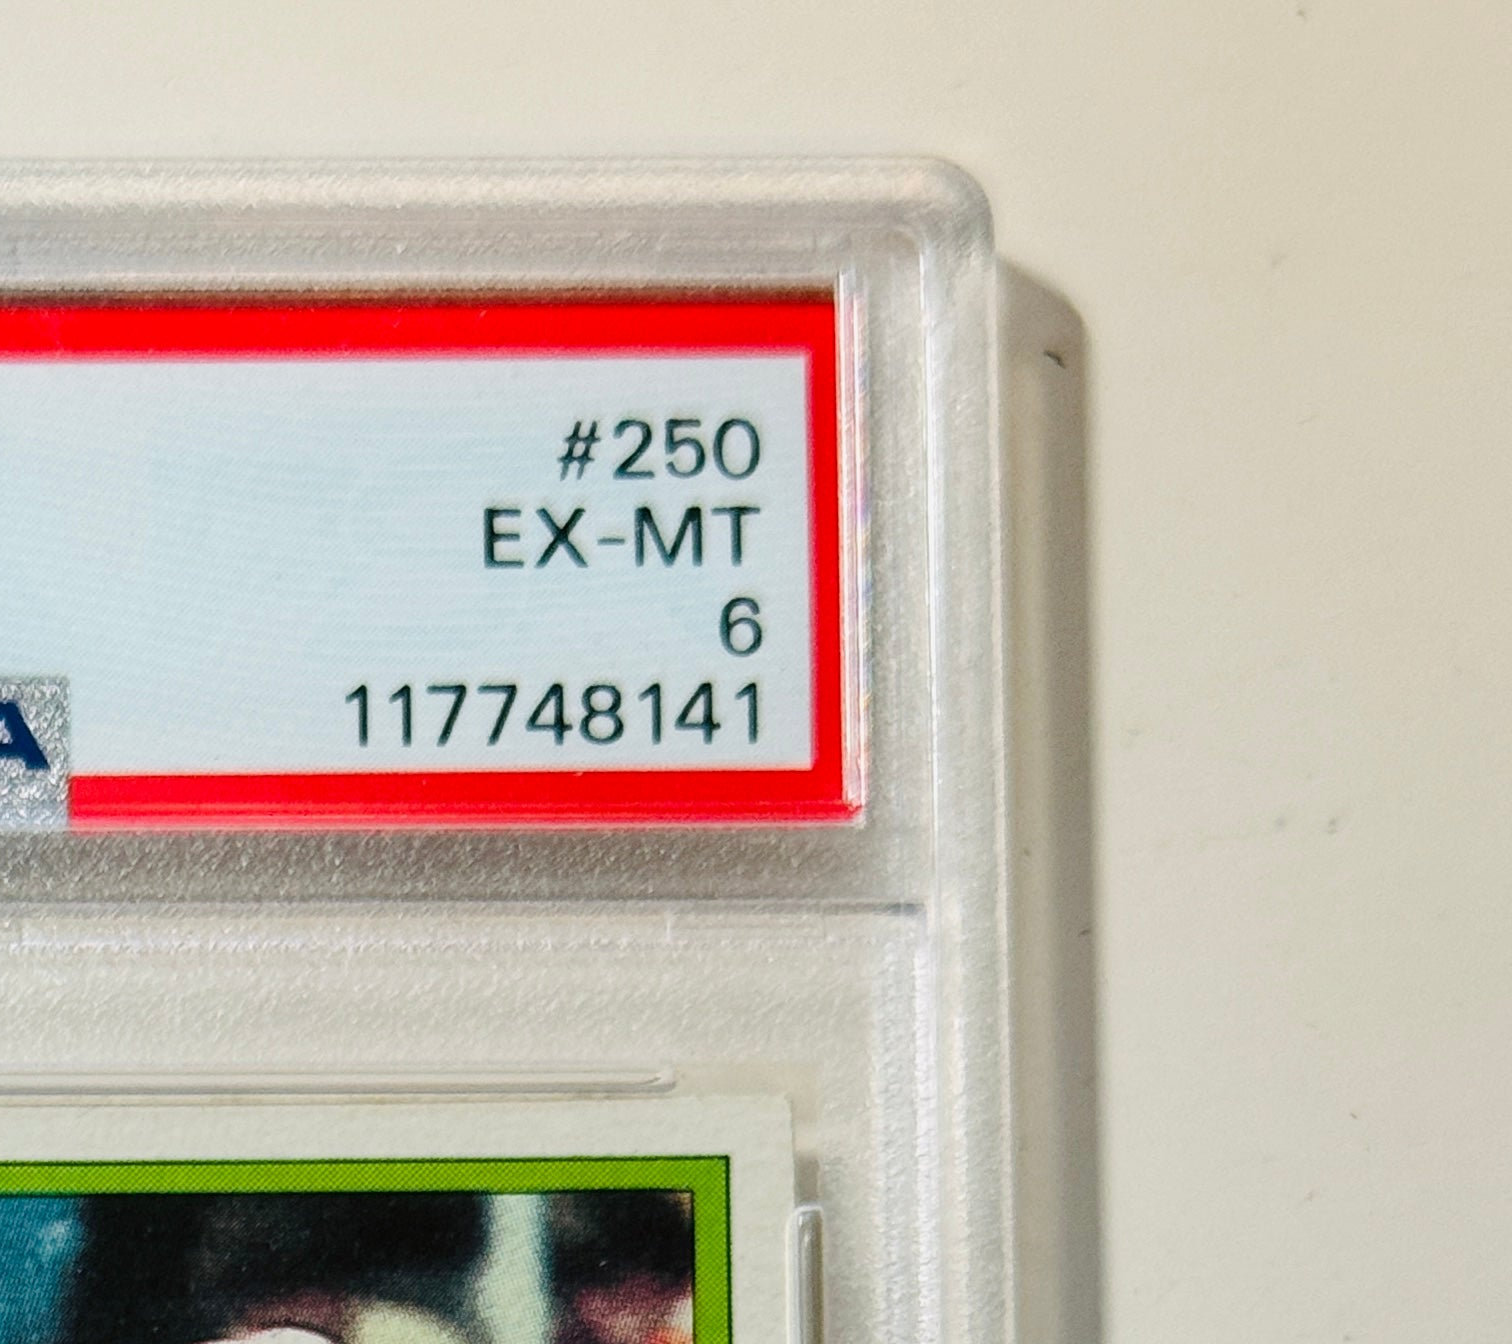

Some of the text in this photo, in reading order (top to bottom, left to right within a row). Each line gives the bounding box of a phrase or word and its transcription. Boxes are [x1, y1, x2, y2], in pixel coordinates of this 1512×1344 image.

[556, 416, 762, 481] #250
[482, 504, 762, 570] EX-MT
[718, 595, 764, 658] 6
[344, 680, 761, 748] 117748141
